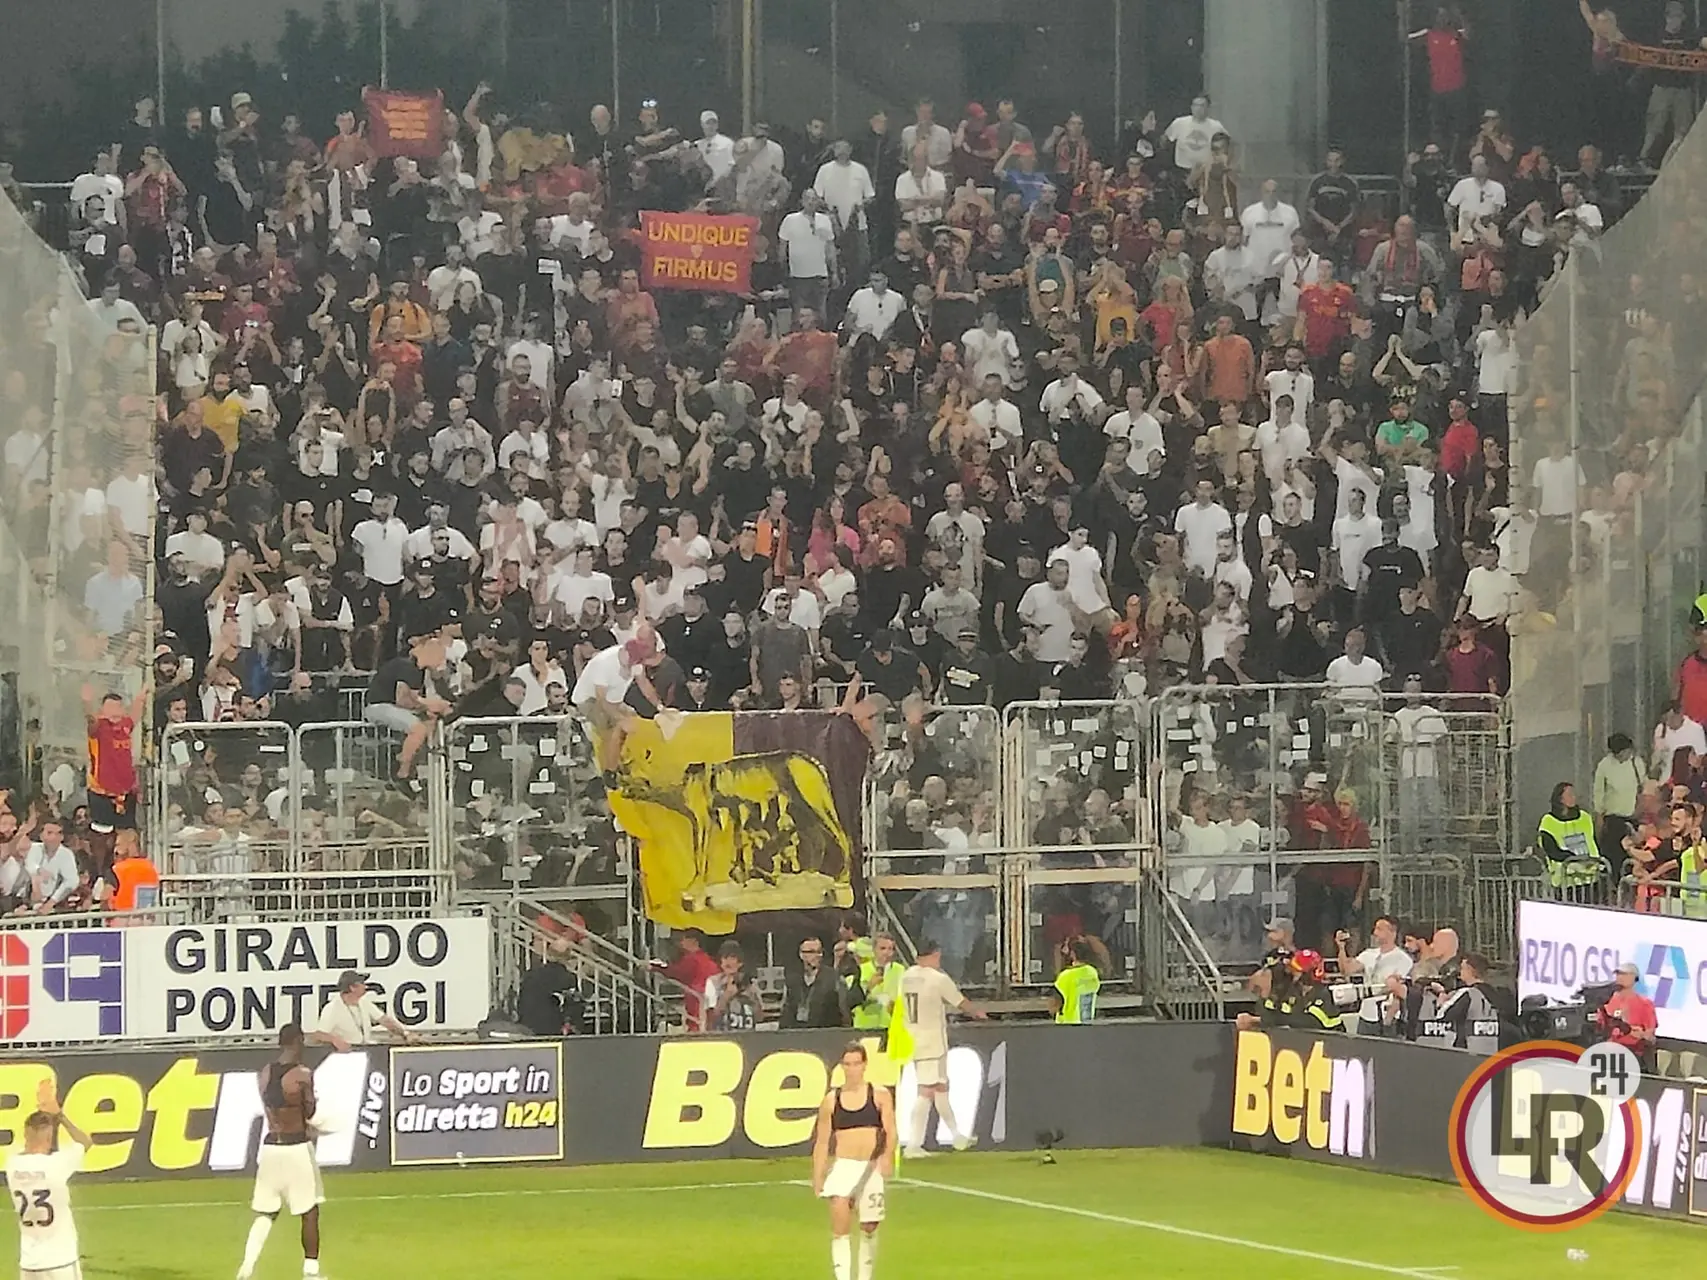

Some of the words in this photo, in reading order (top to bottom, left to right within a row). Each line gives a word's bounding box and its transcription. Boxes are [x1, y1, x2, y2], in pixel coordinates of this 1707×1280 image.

[648, 221, 750, 247] UNDIQUE
[653, 256, 737, 282] FIRMUS
[165, 922, 449, 974] GIRALDO
[1519, 938, 1577, 987] RZIO
[402, 1070, 432, 1097] Lo
[438, 1066, 520, 1099] Sport
[525, 1064, 550, 1092] in
[396, 1103, 498, 1132] diretta
[504, 1100, 557, 1128] h24
[13, 1188, 54, 1228] 23
[868, 1192, 885, 1209] 52
